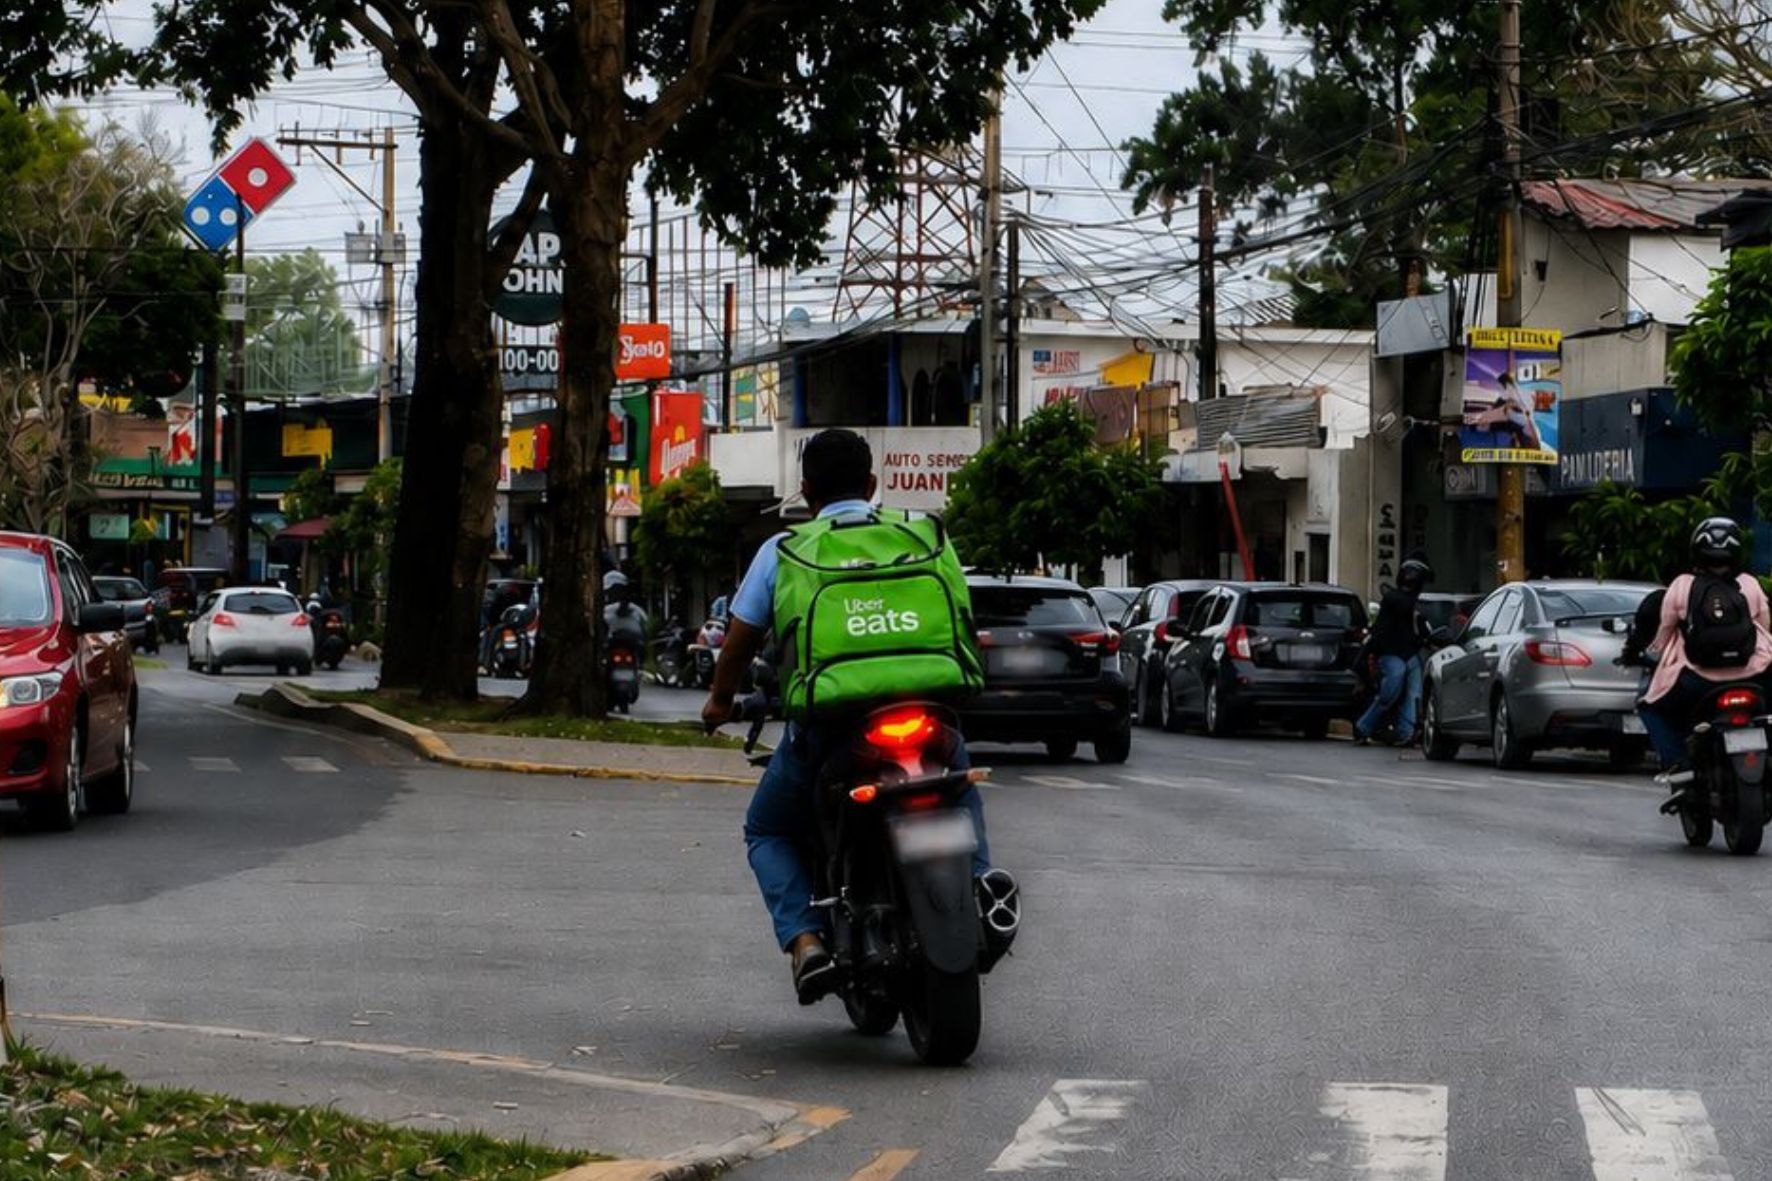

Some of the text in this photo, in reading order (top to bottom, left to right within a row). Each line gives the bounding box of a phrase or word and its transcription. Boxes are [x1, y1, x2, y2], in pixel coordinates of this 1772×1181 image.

[512, 232, 562, 265] AP
[502, 268, 564, 294] OHN
[884, 452, 920, 467] AUTO
[887, 472, 944, 490] JUAN
[843, 597, 884, 614] Uber
[847, 609, 919, 636] eats
